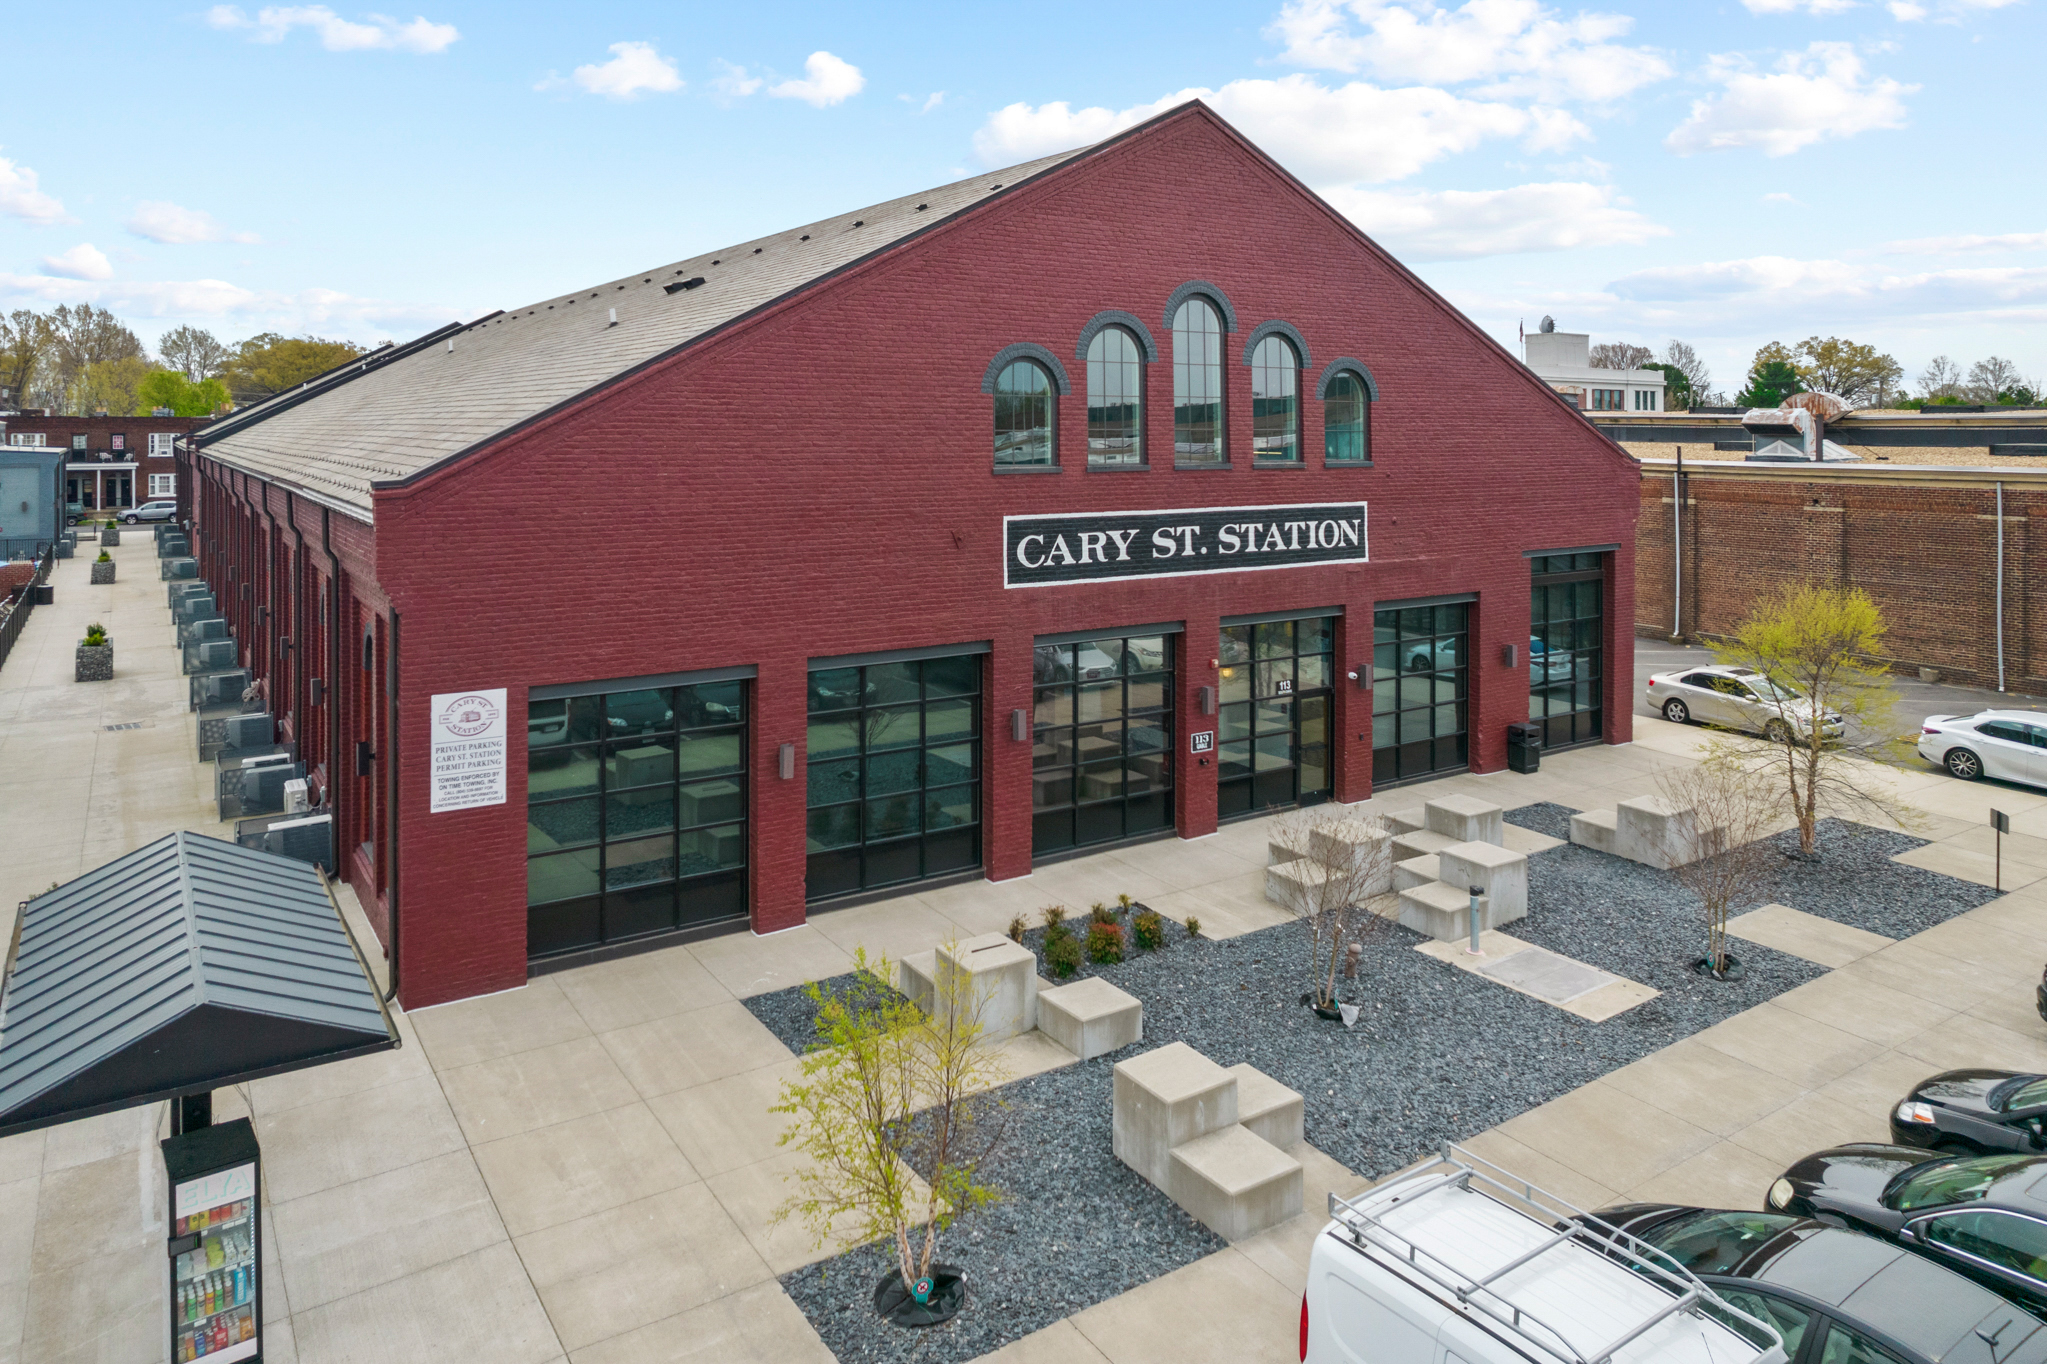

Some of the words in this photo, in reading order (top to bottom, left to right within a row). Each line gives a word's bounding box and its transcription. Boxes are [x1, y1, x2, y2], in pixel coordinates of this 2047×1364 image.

[1016, 528, 1141, 568] CARY
[1152, 525, 1208, 559] ST.
[1218, 519, 1362, 555] STATION
[1279, 680, 1290, 690] 113
[450, 699, 477, 713] CARY
[451, 721, 487, 734] STATION
[435, 744, 467, 754] PRIVATE
[468, 740, 502, 750] PARKING
[435, 755, 456, 763] CARY
[457, 753, 468, 761] ST.
[469, 749, 502, 759] STATION
[436, 763, 466, 772] PERMIT
[467, 758, 502, 768] PARKING
[437, 776, 460, 784] TOWING
[461, 773, 491, 781] ENFORCED
[470, 790, 499, 798] INFORMATION
[432, 801, 462, 809] CONCERNING
